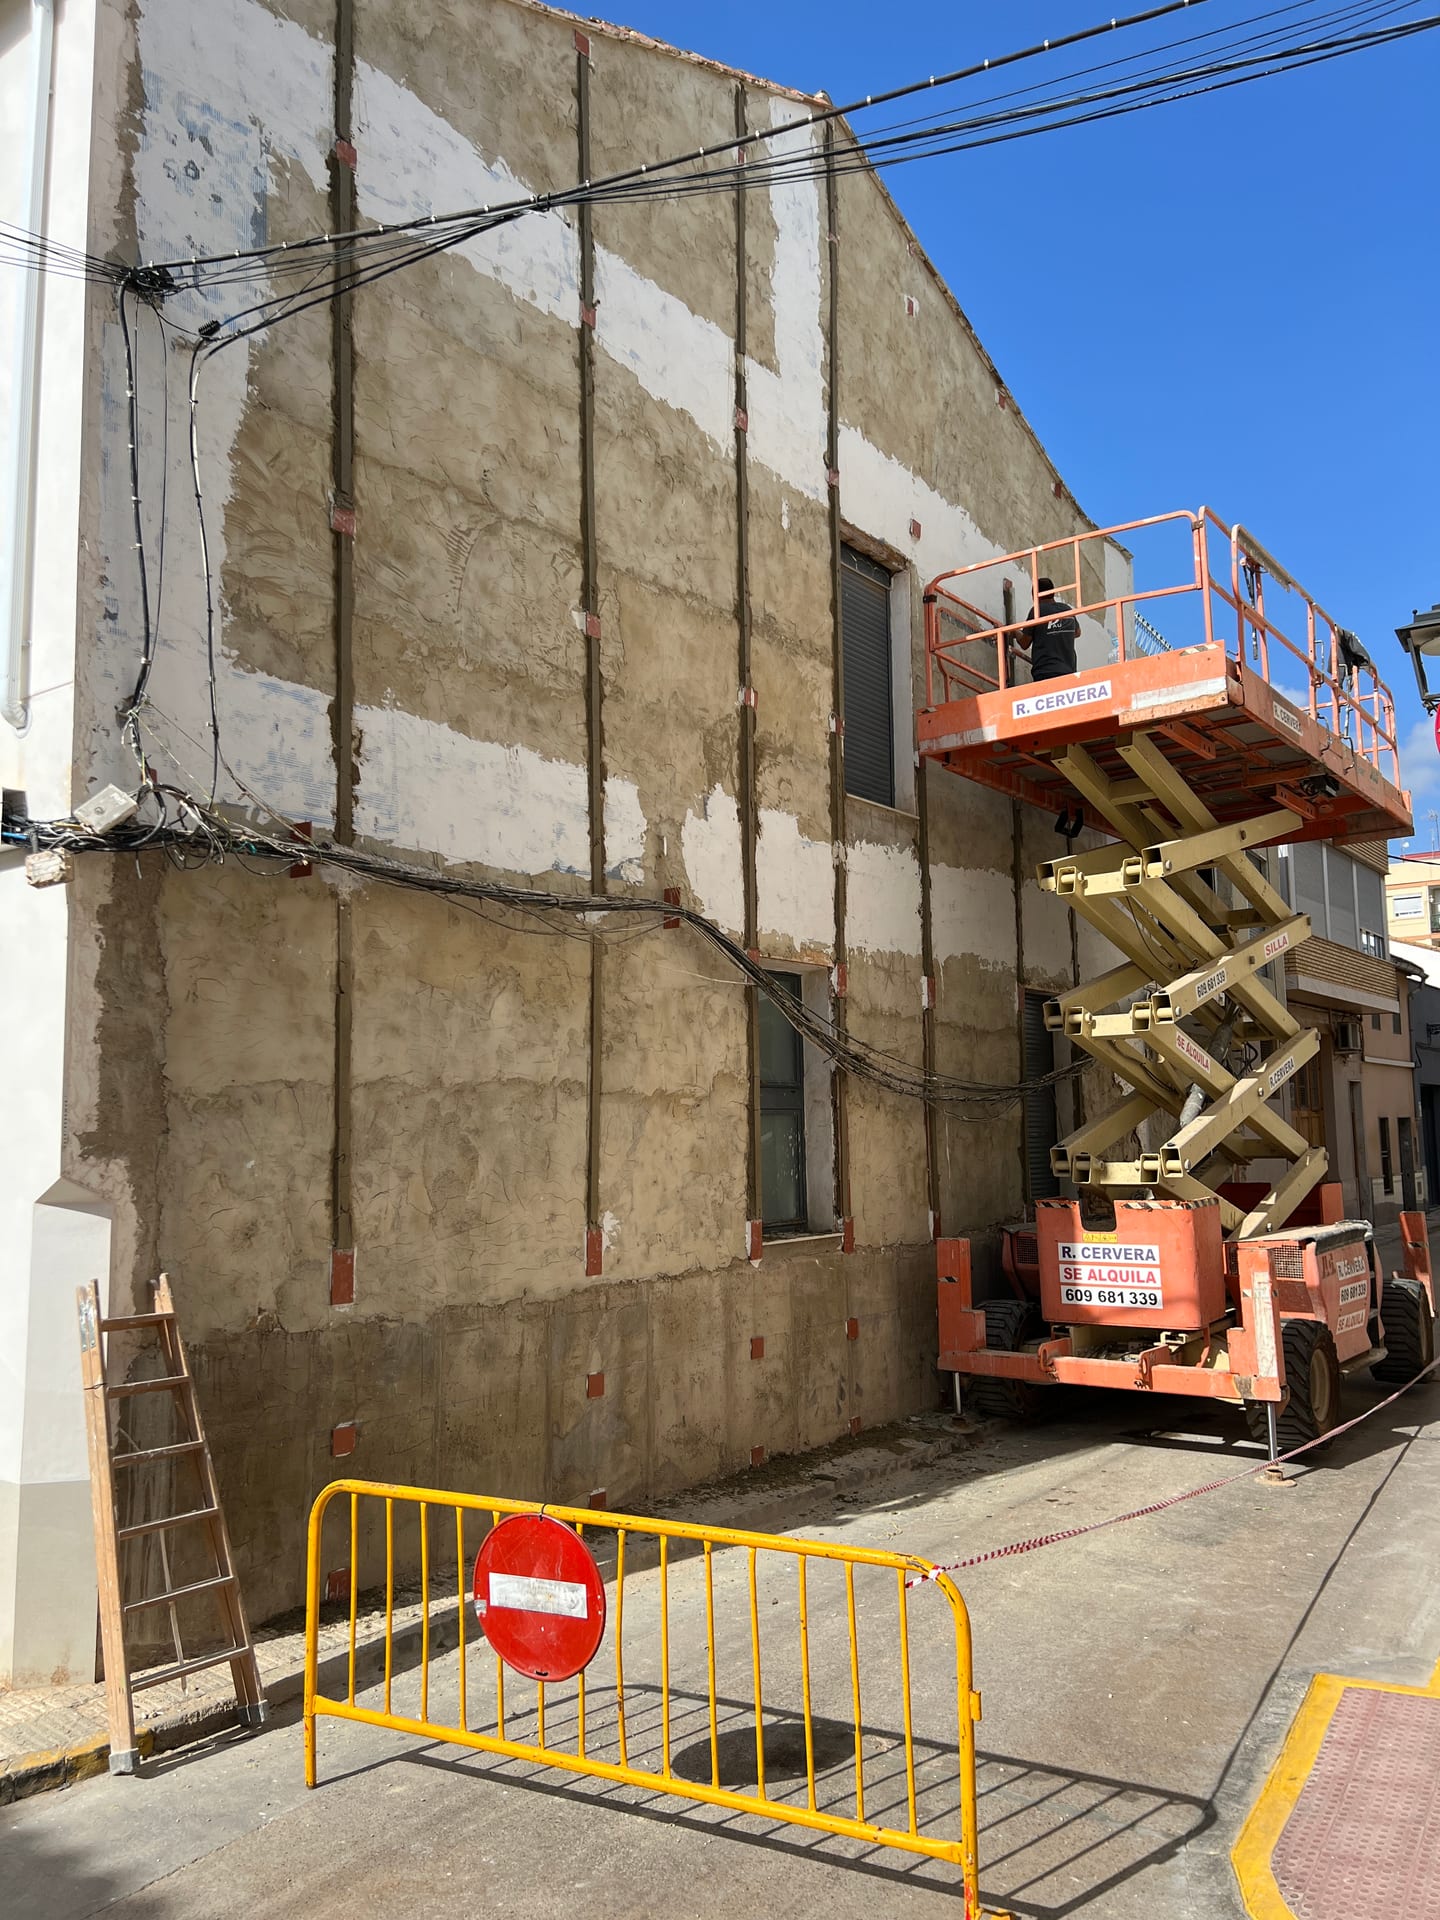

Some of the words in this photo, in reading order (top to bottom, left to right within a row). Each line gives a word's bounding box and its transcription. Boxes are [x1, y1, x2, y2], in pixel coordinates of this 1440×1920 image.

[1016, 703, 1030, 716] R.
[1035, 684, 1109, 711] CERVERA
[1265, 935, 1288, 956] SILLA
[1197, 982, 1207, 998] 609
[1177, 1035, 1185, 1050] SE
[1061, 1246, 1076, 1259] R.
[1081, 1246, 1156, 1261] CERVERA
[1063, 1267, 1082, 1280] SE
[1087, 1268, 1157, 1283] ALQUILA
[1065, 1288, 1093, 1302] 609
[1098, 1290, 1125, 1304] 681
[1129, 1291, 1158, 1306] 339
